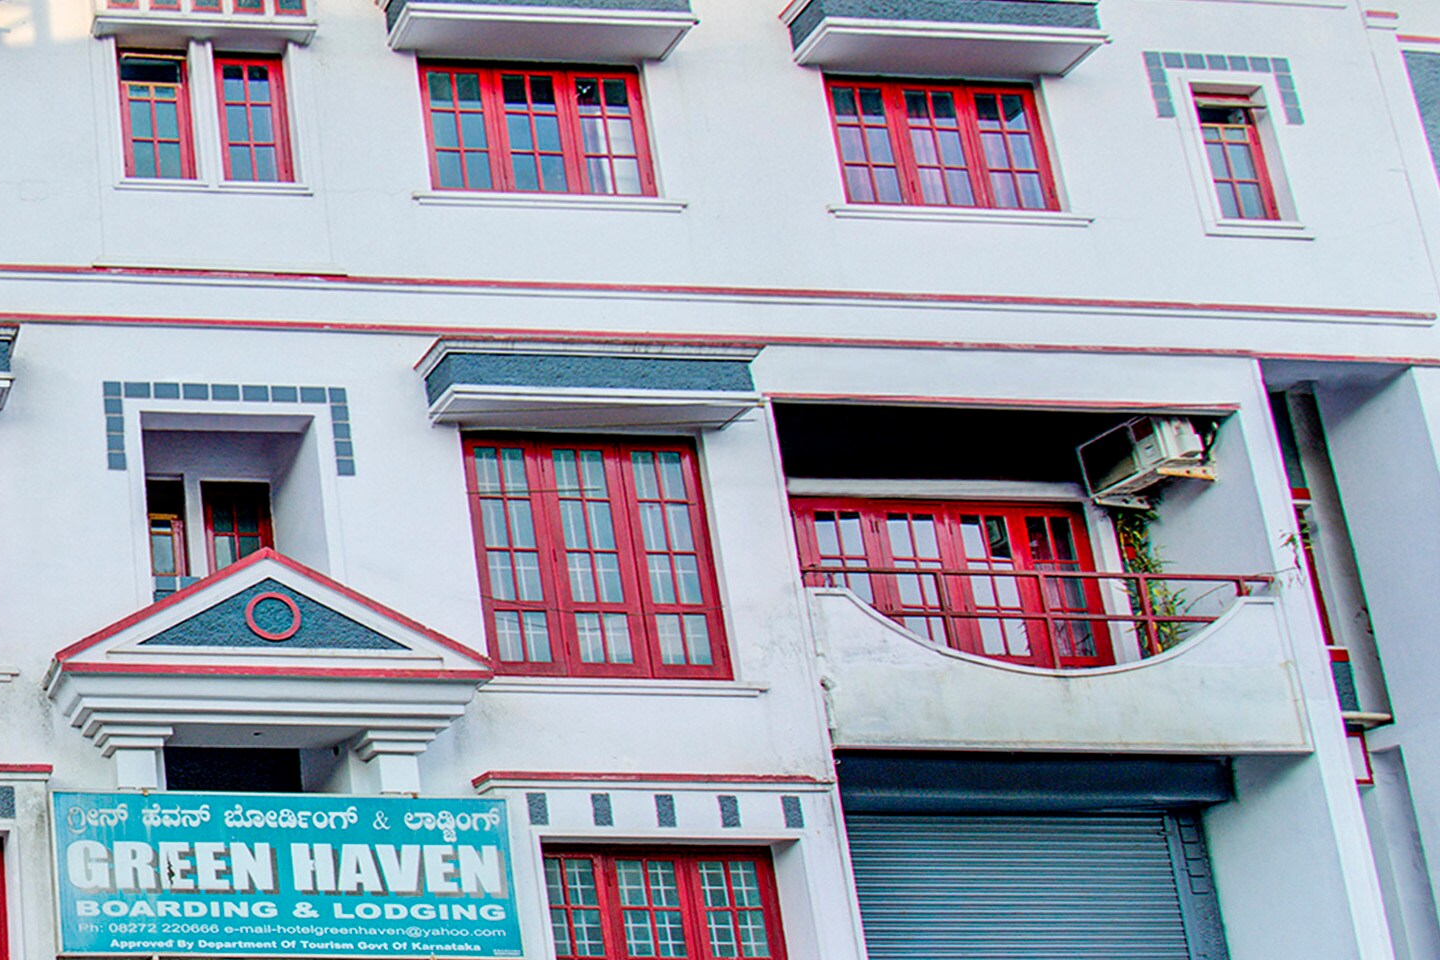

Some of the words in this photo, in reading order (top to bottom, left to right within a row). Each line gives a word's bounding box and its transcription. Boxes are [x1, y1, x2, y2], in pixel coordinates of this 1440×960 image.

[372, 810, 392, 831] &
[66, 840, 274, 892] GREEN
[291, 843, 504, 895] HAVEN
[75, 900, 279, 919] BOARDING
[292, 901, 320, 919] &
[332, 902, 507, 921] LODGING
[77, 923, 104, 934] Ph:
[108, 923, 158, 934] 08272
[161, 923, 220, 935] 220666
[223, 923, 507, 938] e-mail-hotelgreenhaven@yahoo.com
[110, 938, 174, 950] Approved
[177, 939, 194, 950] By
[198, 939, 277, 950] Department
[280, 940, 297, 949] Of
[300, 940, 354, 950] Tourism
[357, 941, 389, 951] Govt
[392, 941, 408, 951] Of
[412, 942, 482, 952] Karnataka
